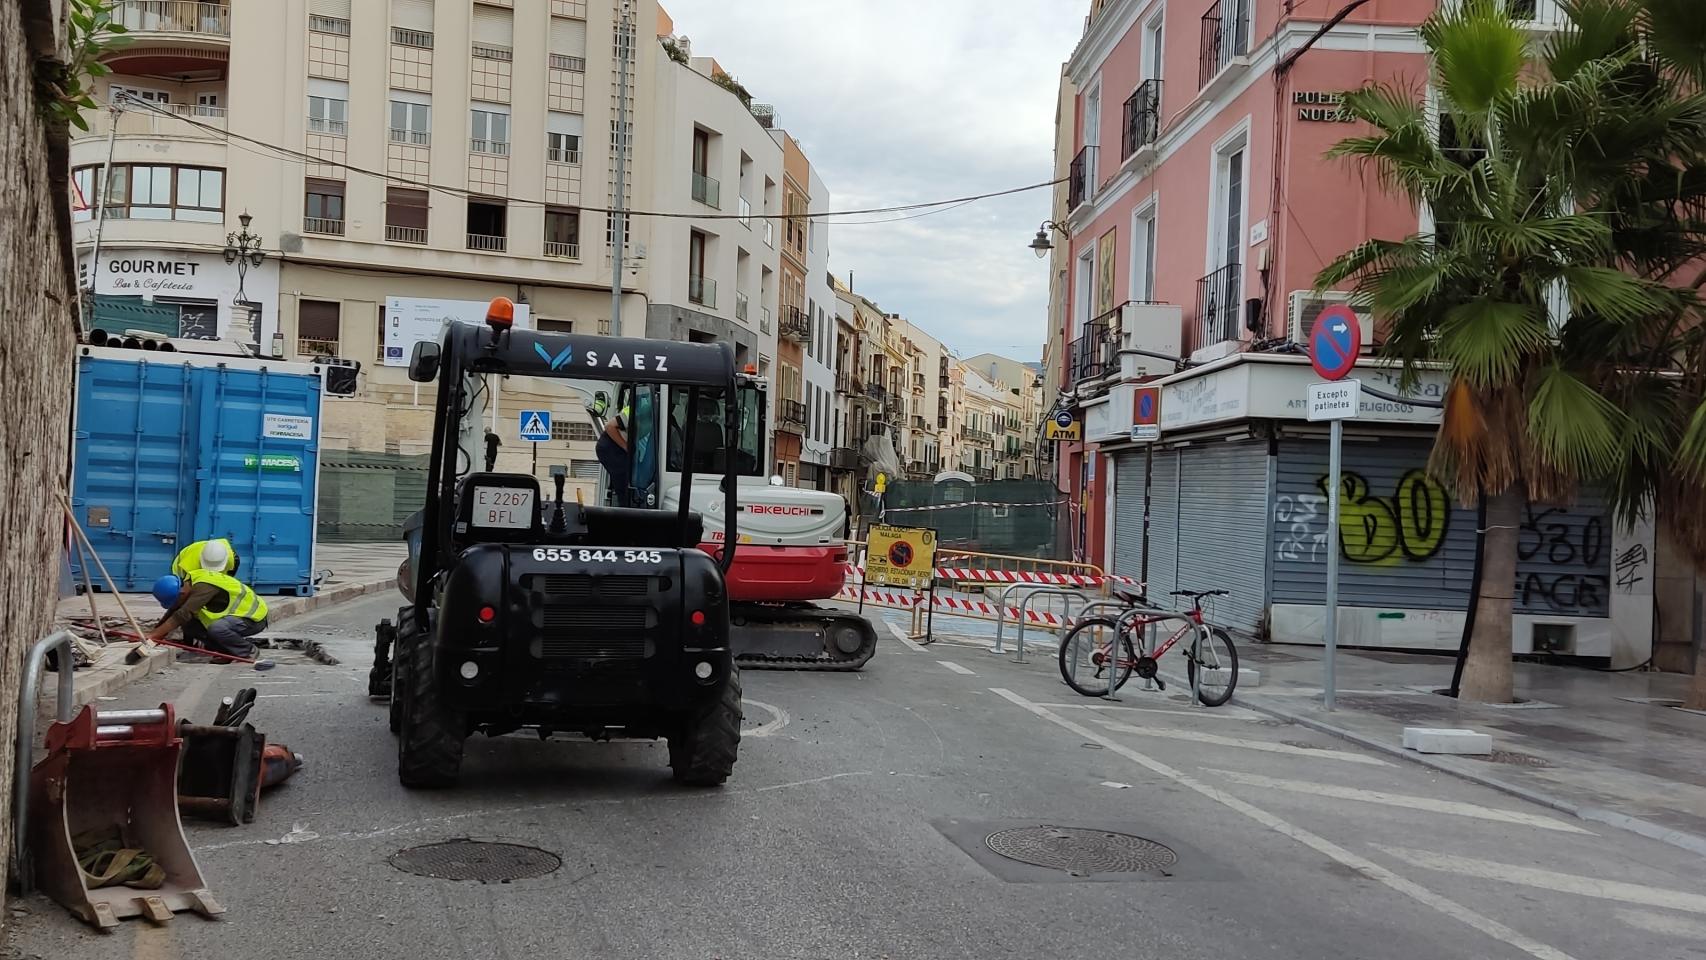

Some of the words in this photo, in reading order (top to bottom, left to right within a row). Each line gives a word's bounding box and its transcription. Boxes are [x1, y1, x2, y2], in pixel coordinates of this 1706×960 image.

[109, 259, 200, 276] GOURMET
[112, 277, 132, 289] Bar
[133, 279, 141, 289] &
[143, 278, 194, 292] Cafeteria
[585, 350, 668, 372] SAEZ
[1317, 390, 1349, 400] Excepto
[1314, 400, 1350, 412] patinetes
[1359, 402, 1414, 414] ELIGIOSOS
[1051, 430, 1075, 439] ATM
[479, 491, 488, 505] E
[493, 492, 529, 506] 2267
[488, 510, 517, 524] BFL
[532, 548, 573, 562] 655
[578, 549, 618, 563] 844
[624, 550, 662, 564] 545
